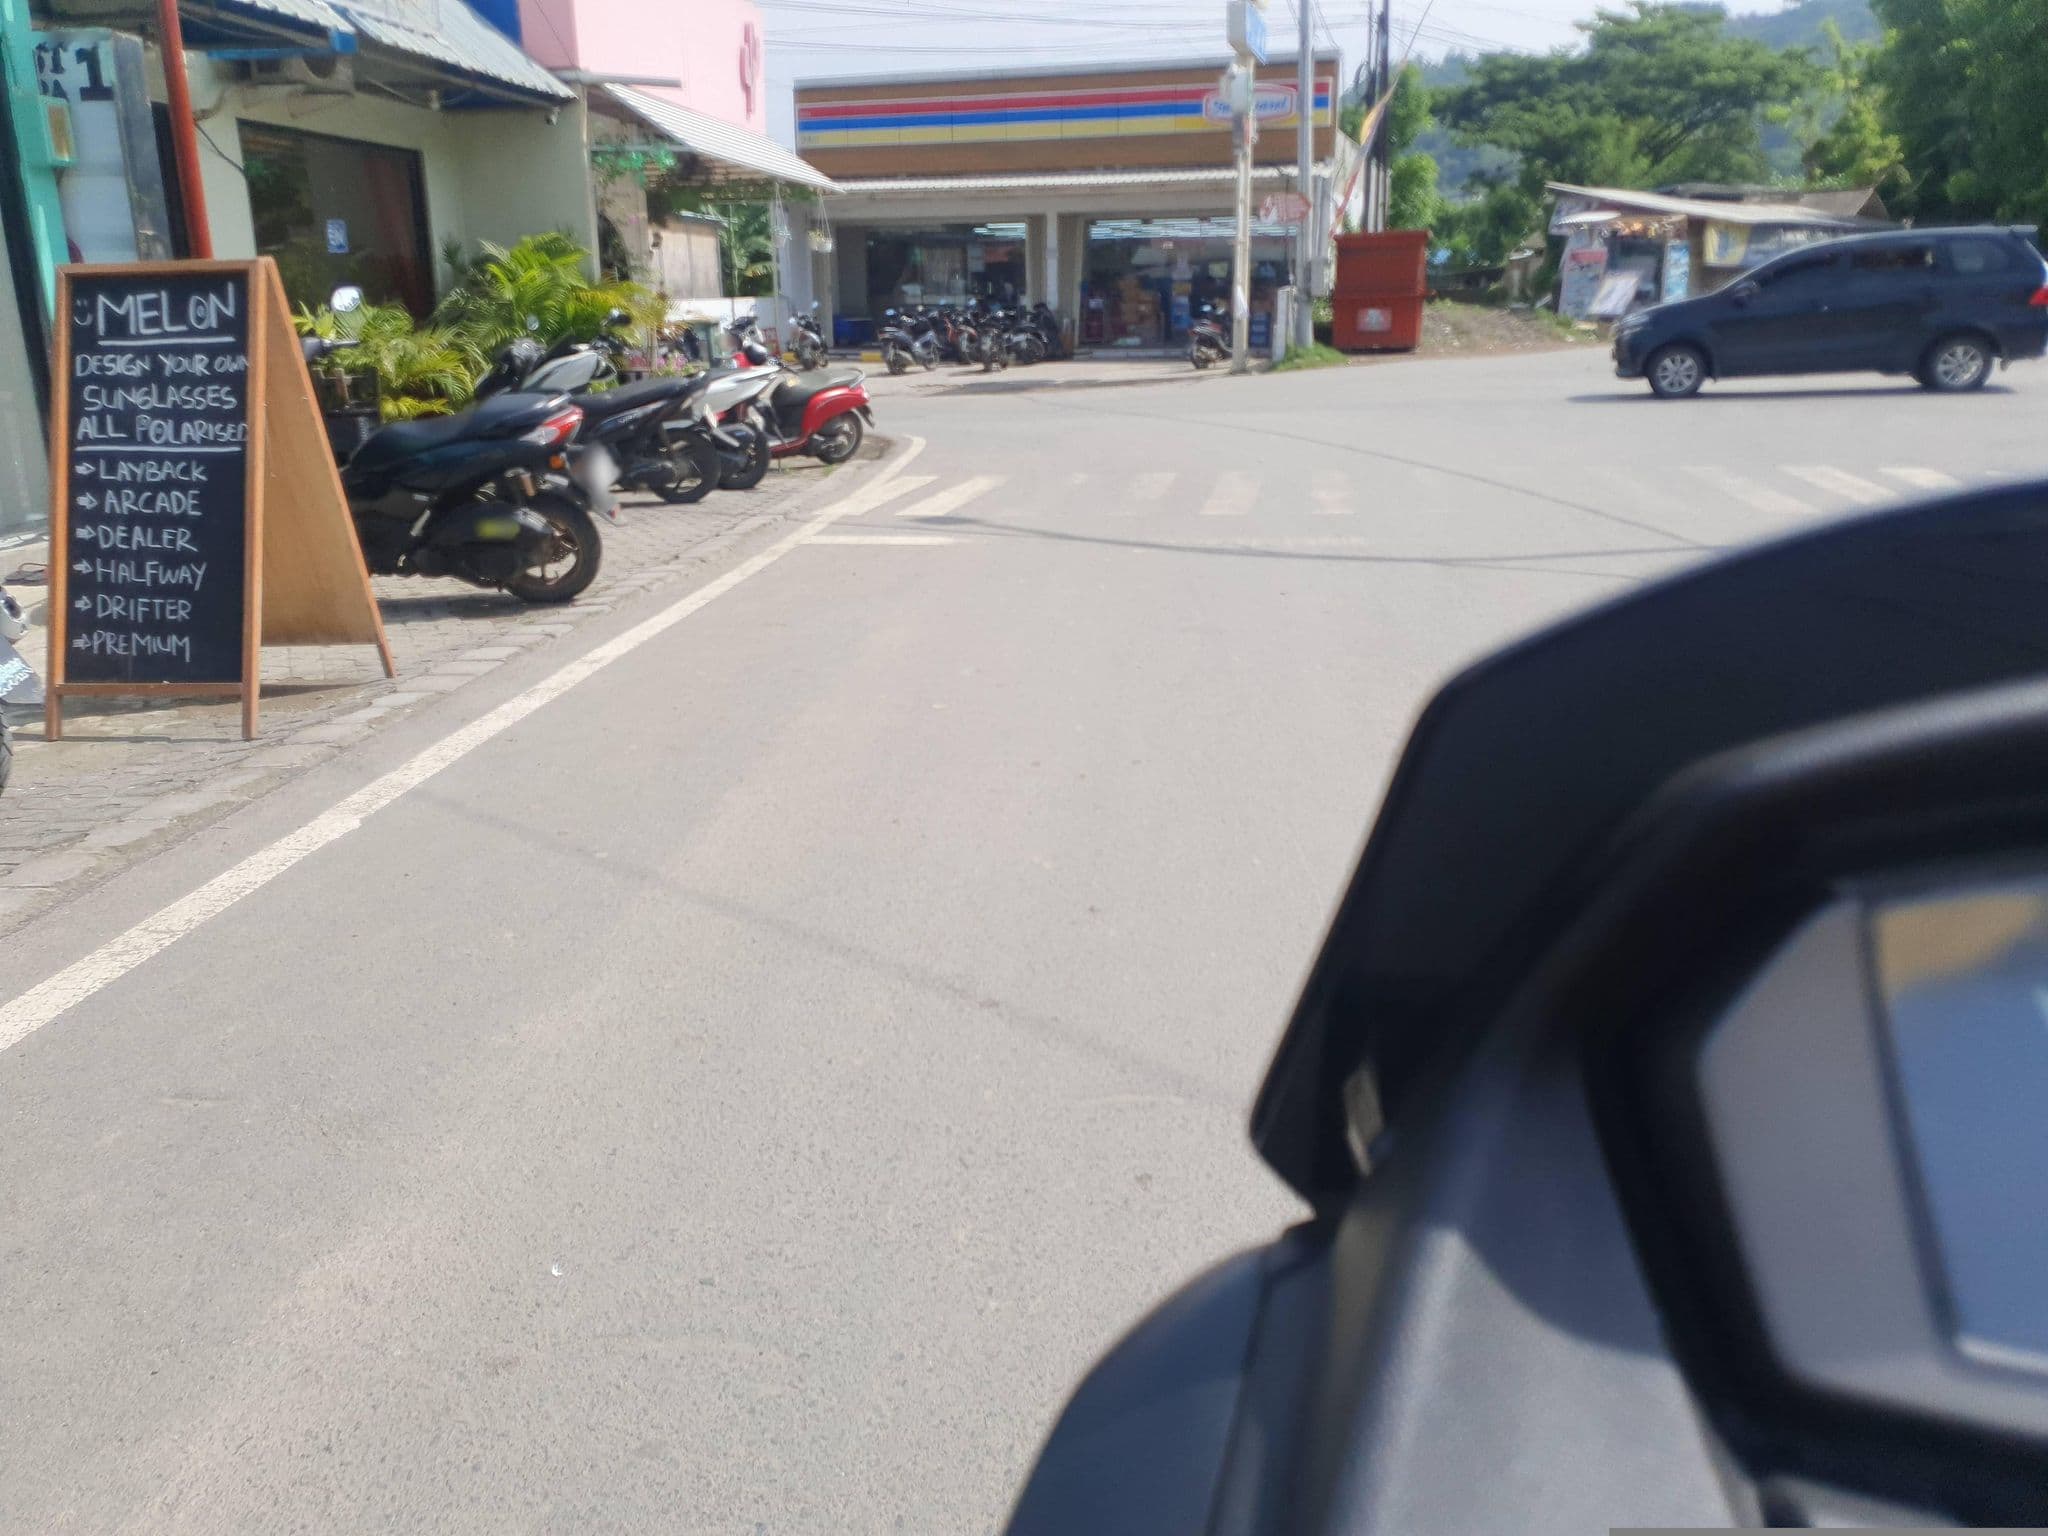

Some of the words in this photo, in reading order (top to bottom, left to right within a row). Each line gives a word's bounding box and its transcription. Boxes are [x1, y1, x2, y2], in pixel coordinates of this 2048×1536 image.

[97, 281, 235, 336] MELON
[75, 353, 151, 377] DESIGN
[157, 353, 211, 377] YOUR
[213, 354, 250, 373] OWN
[83, 382, 238, 411] SUNGLASSES
[76, 414, 128, 440] ALL
[135, 414, 248, 444] POLARISED
[99, 459, 208, 482] LAYBACK
[104, 489, 203, 516] ARCADE
[97, 525, 199, 552] DEALER
[95, 558, 207, 592] HALFWAY
[96, 593, 192, 623] DRIFTER
[91, 630, 191, 663] PREMIUM
